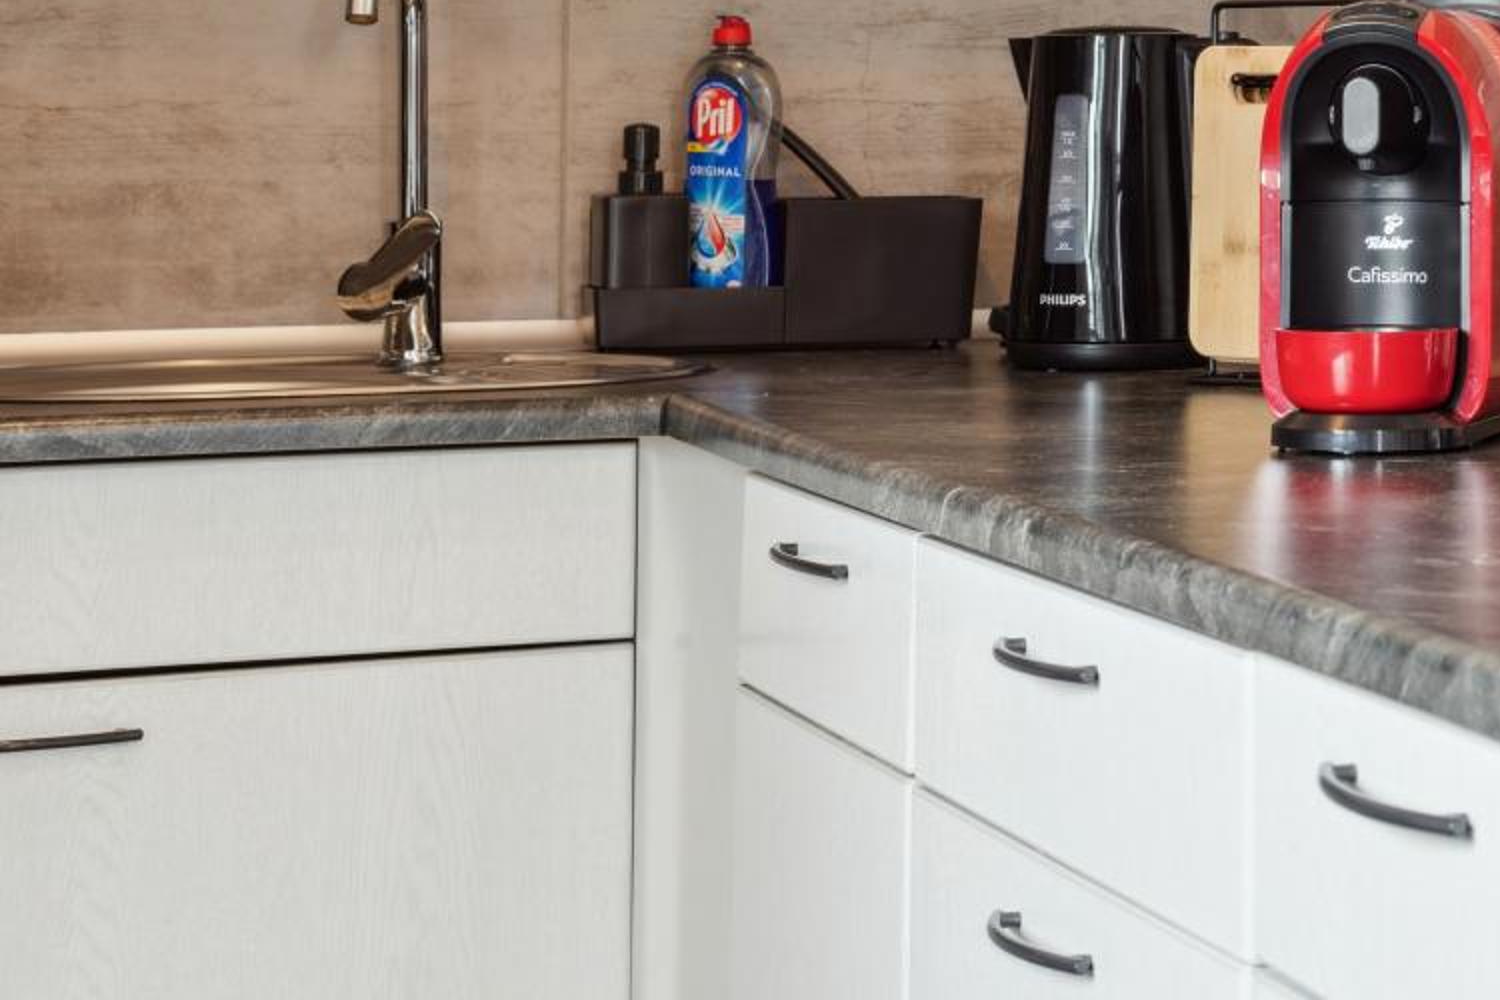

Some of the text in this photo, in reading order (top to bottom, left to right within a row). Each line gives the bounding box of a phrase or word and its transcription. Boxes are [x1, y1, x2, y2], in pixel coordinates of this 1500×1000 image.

[696, 96, 735, 139] Pril
[689, 165, 741, 177] ORIGINAL
[1347, 266, 1428, 284] Cafissimo
[1039, 293, 1086, 306] PHILIPS
